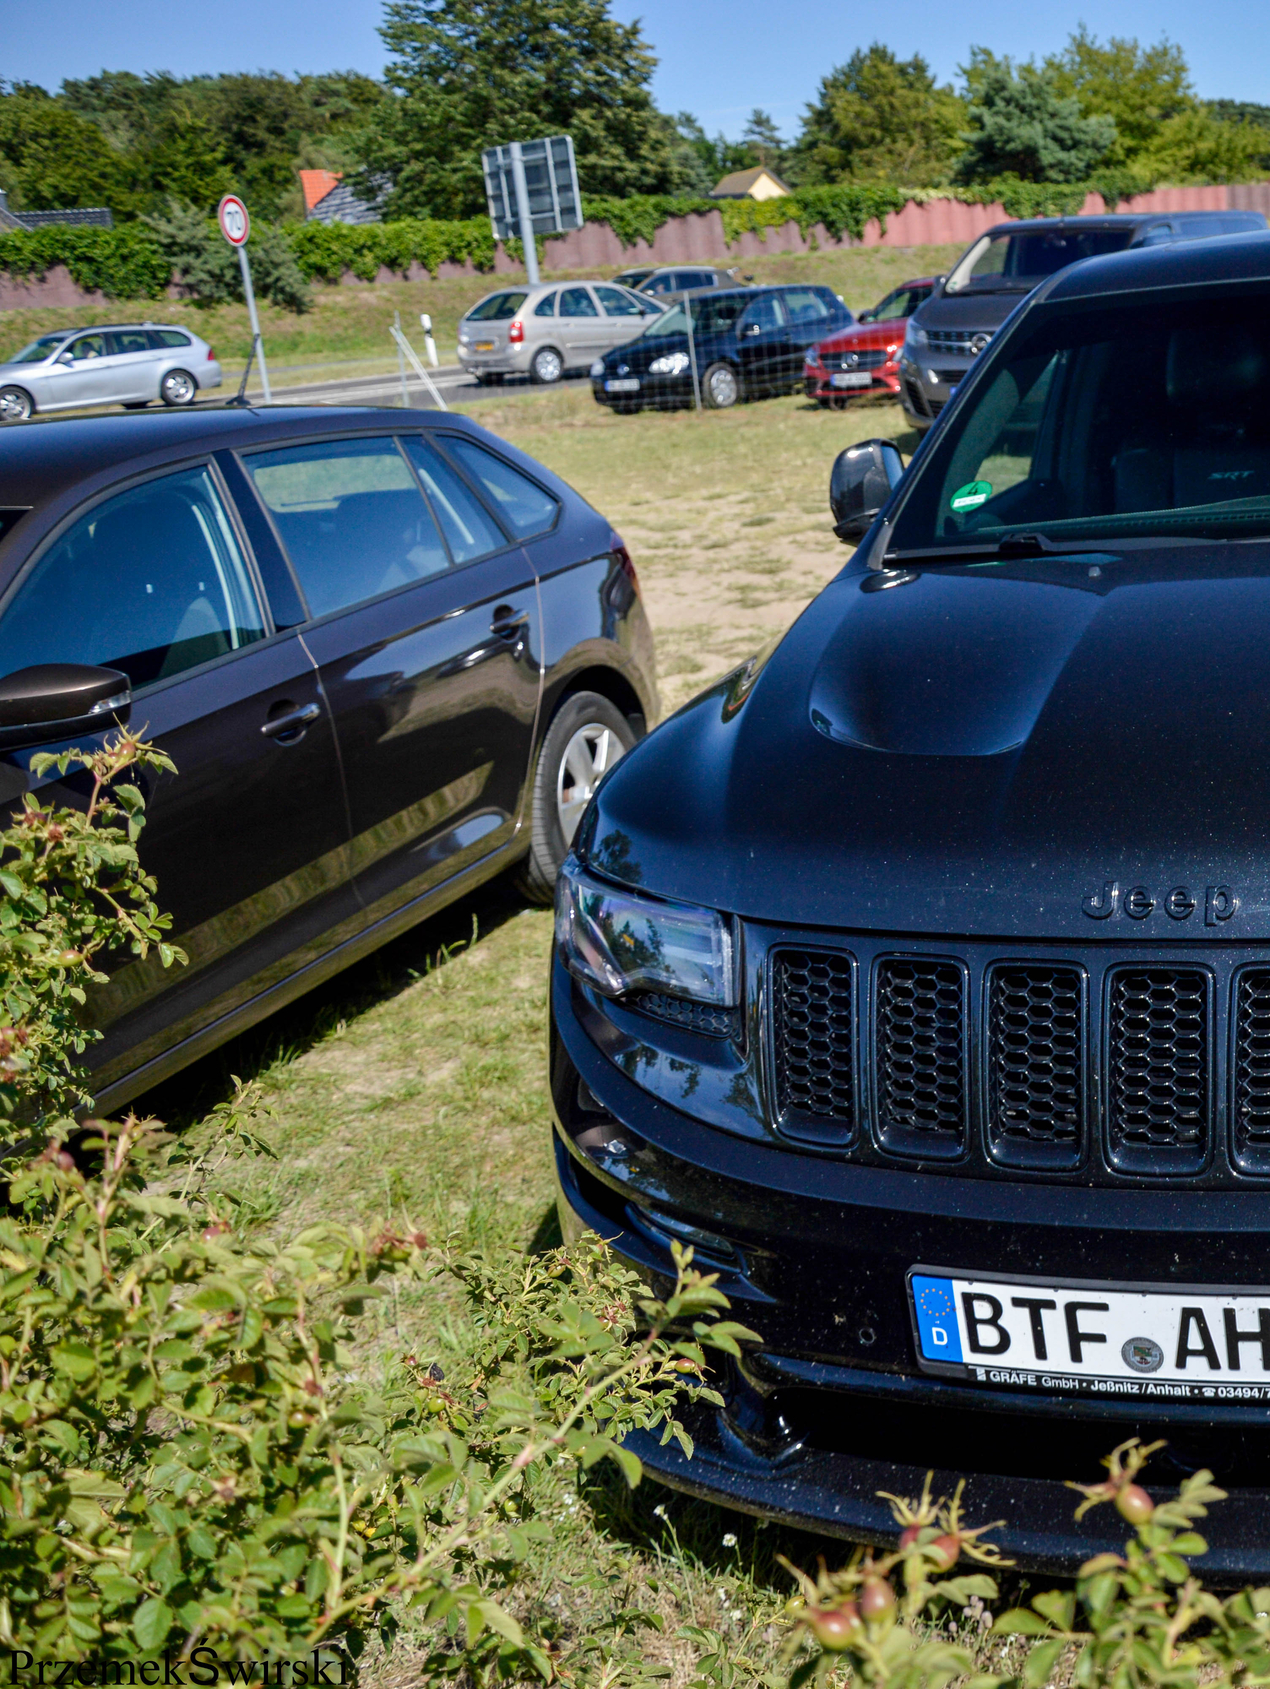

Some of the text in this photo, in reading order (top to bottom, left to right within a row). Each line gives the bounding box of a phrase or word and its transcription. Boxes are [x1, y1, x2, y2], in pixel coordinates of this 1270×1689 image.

[227, 210, 243, 232] 70
[1207, 470, 1256, 481] SRT
[967, 482, 979, 494] 4
[1082, 881, 1239, 927] Jeep
[931, 1326, 949, 1346] D
[960, 1291, 1110, 1363] BTF
[989, 1371, 1037, 1386] GRÄFE
[1041, 1376, 1080, 1390] GmbH
